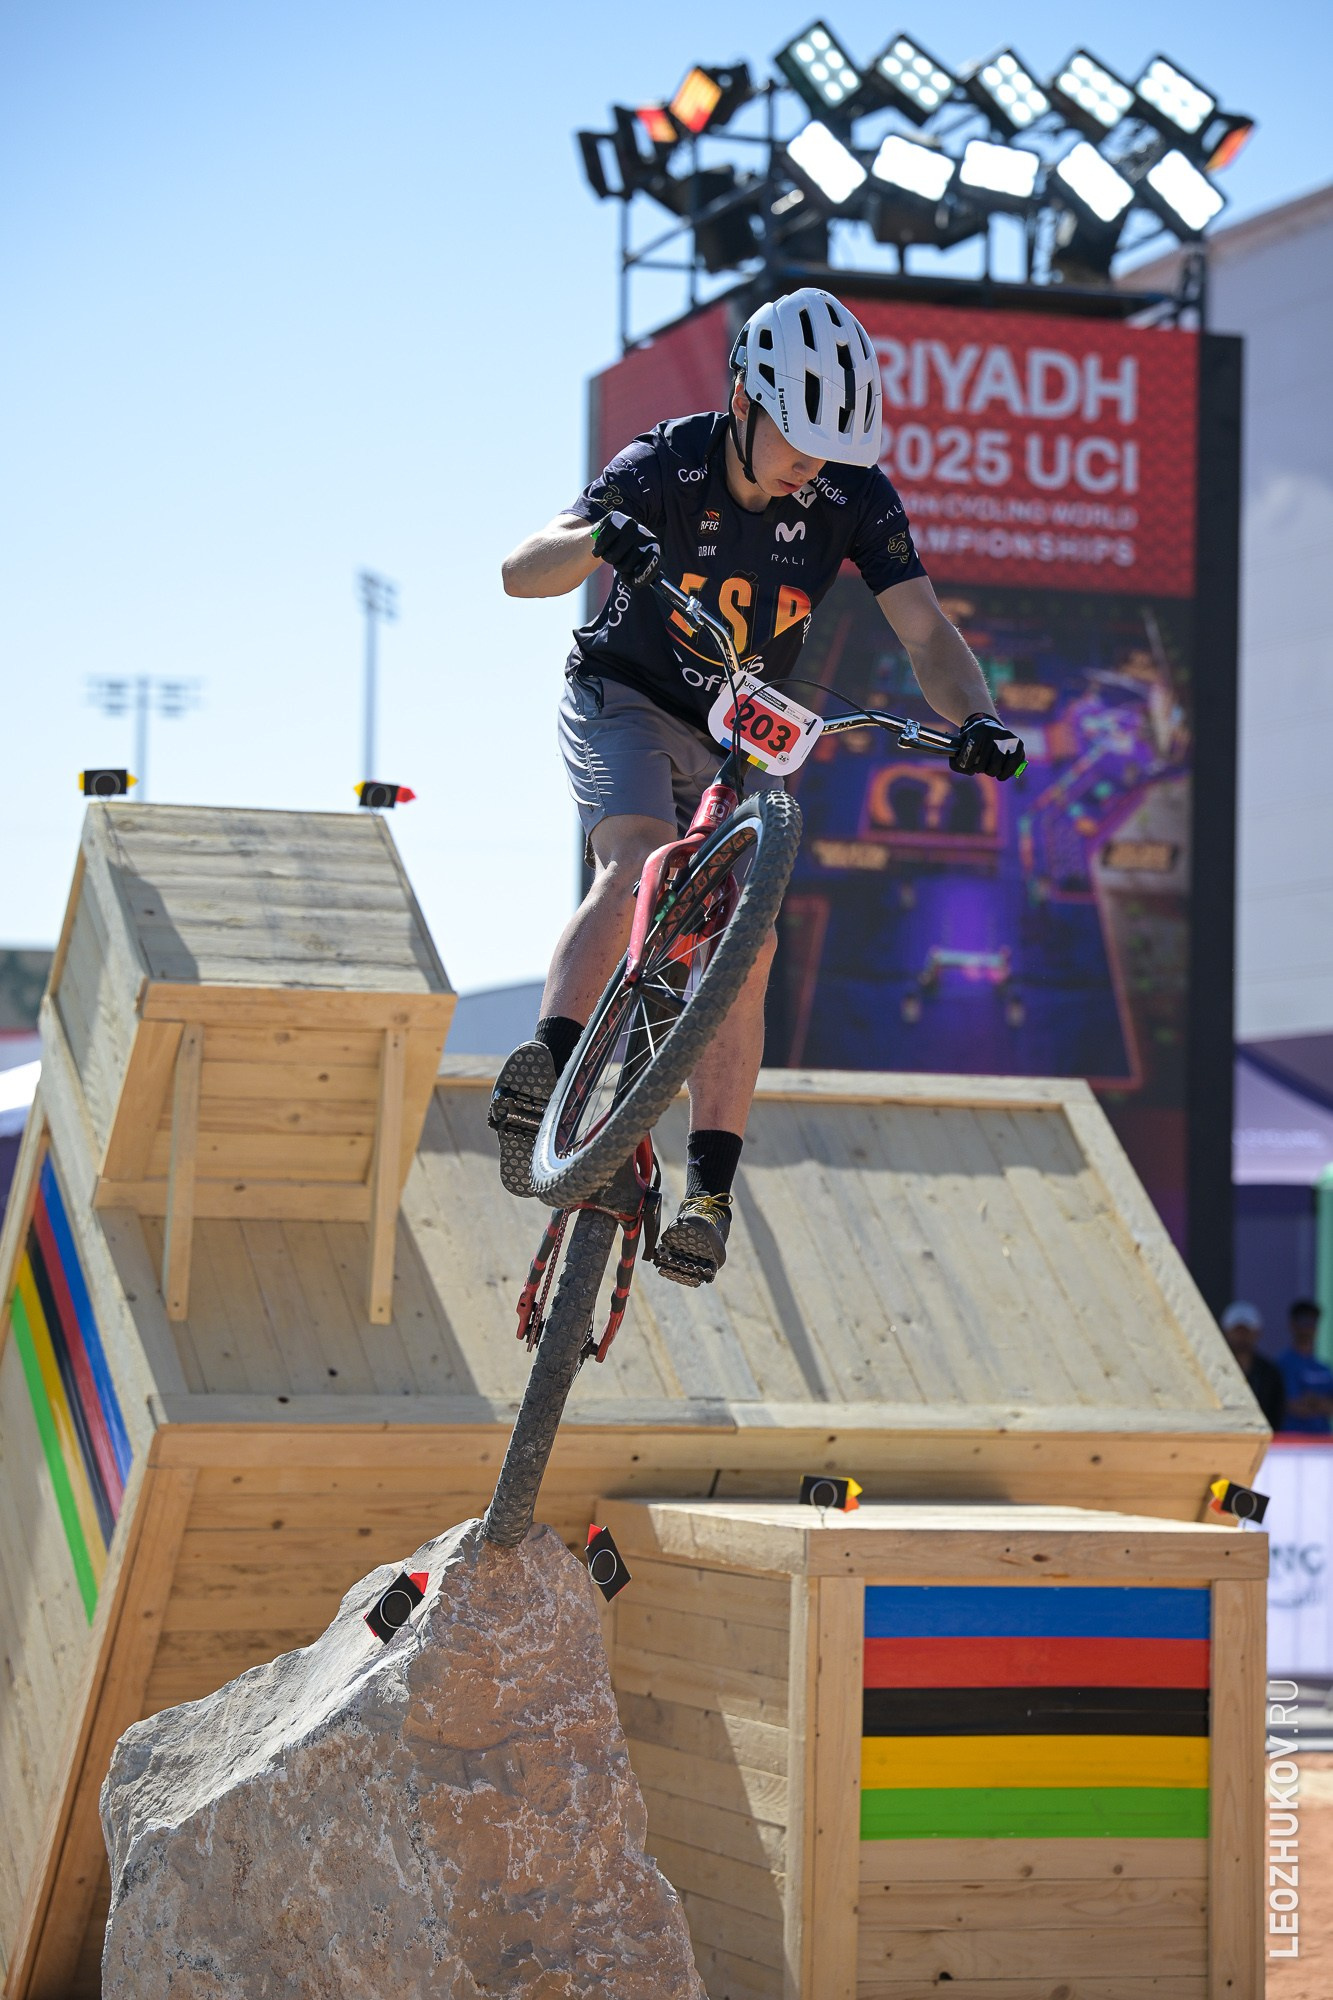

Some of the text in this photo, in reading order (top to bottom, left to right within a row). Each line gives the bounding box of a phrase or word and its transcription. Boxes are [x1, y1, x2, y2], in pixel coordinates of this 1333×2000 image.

[874, 338, 1138, 424] RIYADH
[879, 421, 1138, 493] 2025 UCI
[700, 520, 720, 531] RFEC
[771, 553, 805, 566] RALI
[743, 680, 757, 692] UCI
[730, 702, 792, 752] 203
